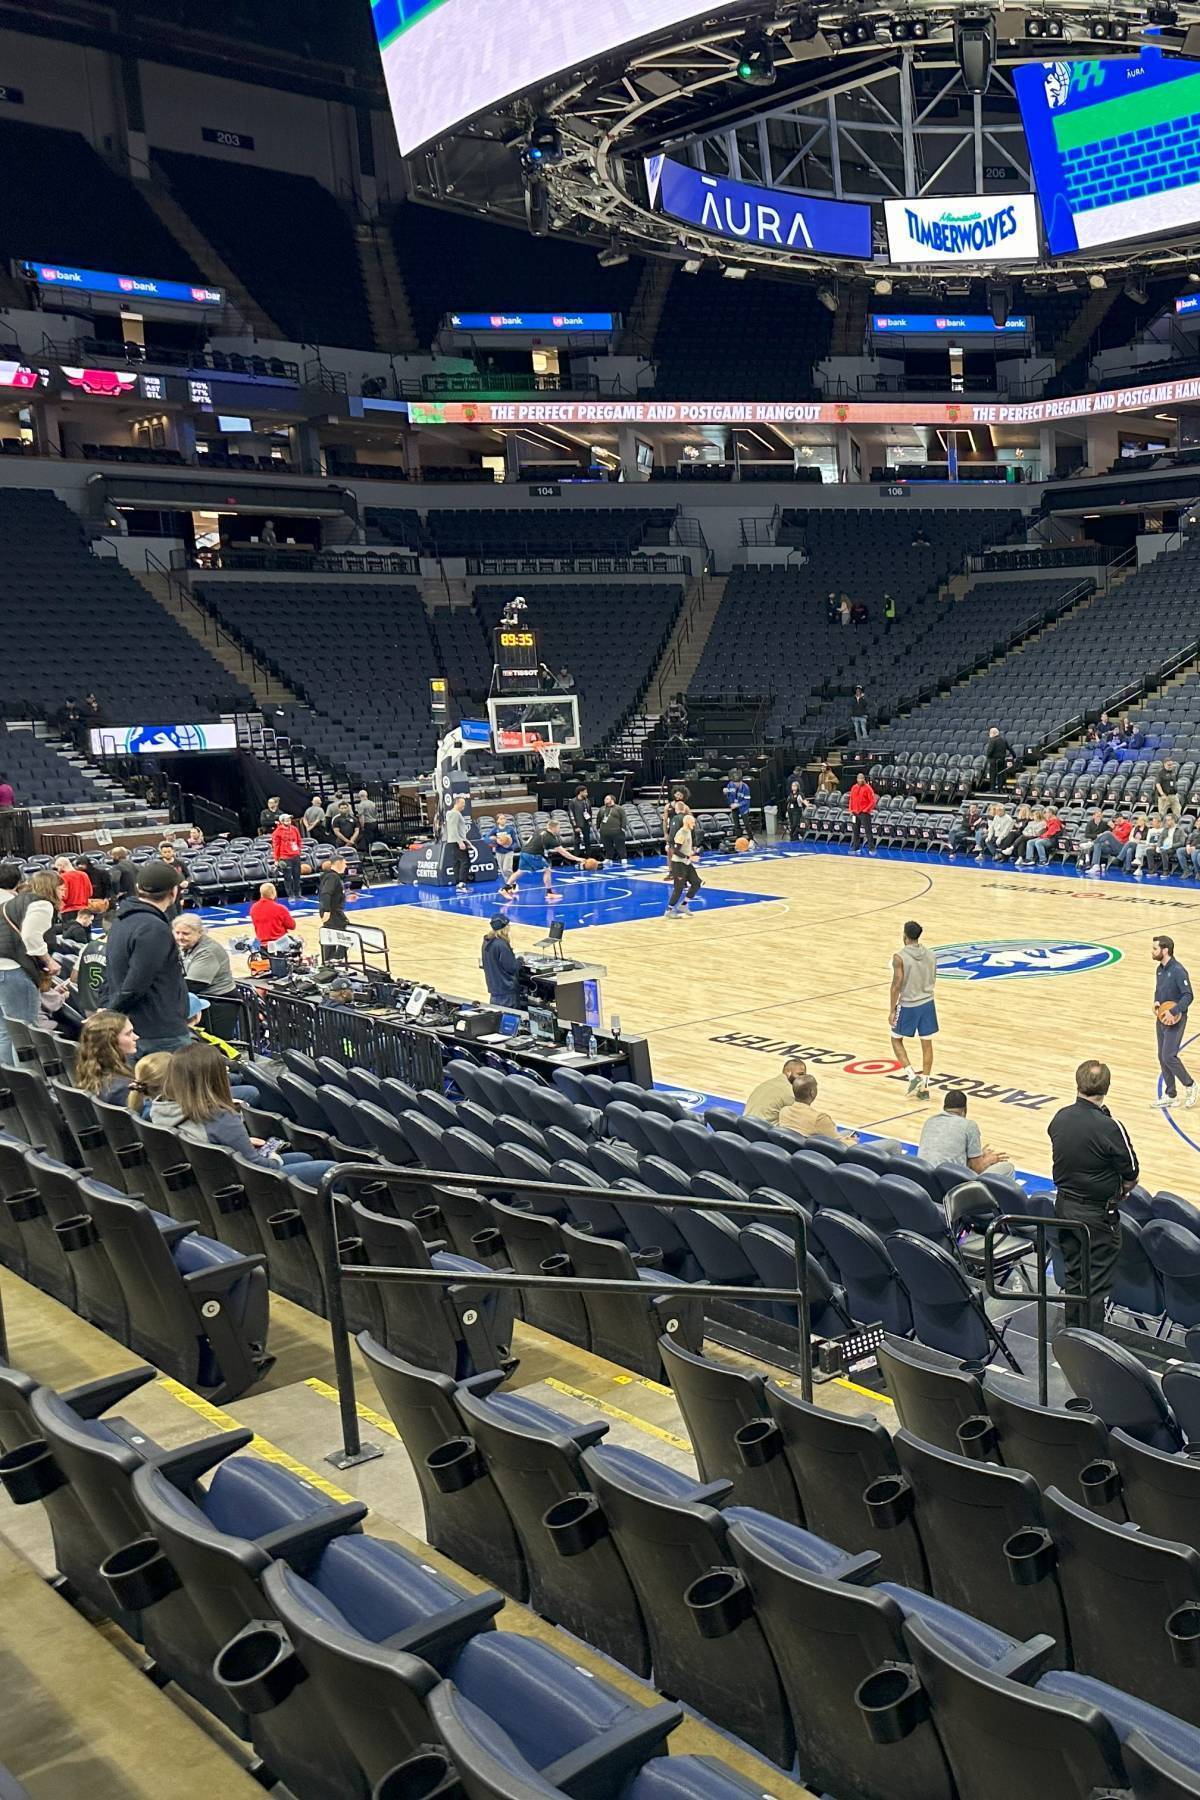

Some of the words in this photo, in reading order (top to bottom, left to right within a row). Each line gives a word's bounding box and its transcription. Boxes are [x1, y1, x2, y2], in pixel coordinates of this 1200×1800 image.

[217, 132, 240, 146] 203
[986, 168, 1006, 178] 206
[904, 205, 1017, 253] TIMBERWOLVES
[56, 270, 82, 282] bank
[132, 281, 157, 292] bank
[973, 407, 996, 421] THE
[999, 405, 1044, 421] PERFECT
[1045, 400, 1092, 417] PREGAME
[1093, 396, 1115, 410] AND
[1117, 385, 1173, 407] POSTGAME
[490, 406, 517, 420] THE
[518, 406, 575, 420] PERFECT
[577, 406, 644, 420] PREGAME
[646, 405, 676, 420] AND
[679, 405, 752, 420] POSTGAME
[756, 405, 821, 420] HANGOUT
[537, 487, 553, 495] 104
[887, 487, 903, 496] 106
[501, 633, 533, 647] 89:35
[513, 669, 539, 677] TISSOT
[417, 861, 438, 870] TARGET
[416, 869, 438, 879] CENTER
[88, 966, 105, 991] 5
